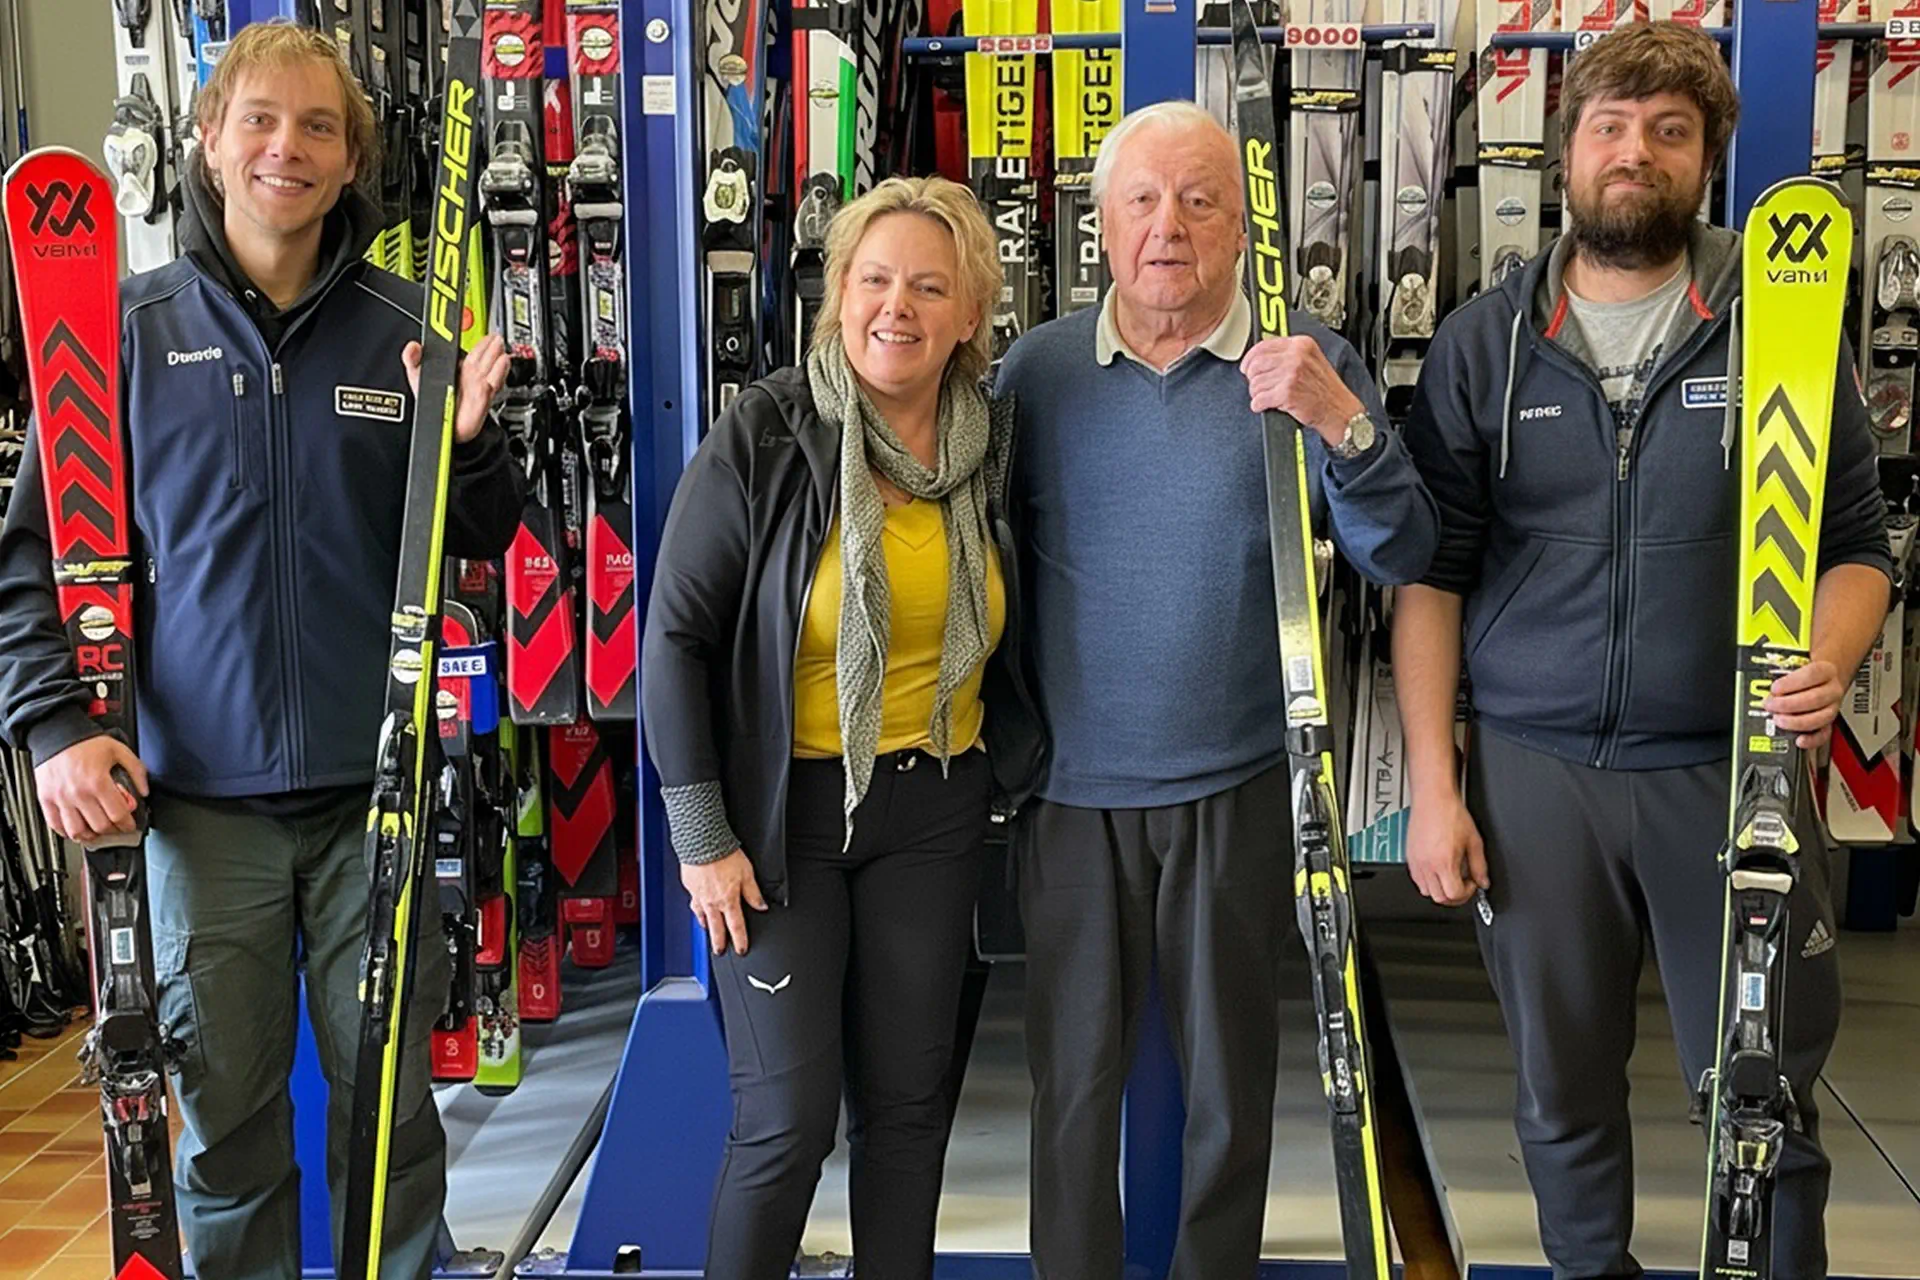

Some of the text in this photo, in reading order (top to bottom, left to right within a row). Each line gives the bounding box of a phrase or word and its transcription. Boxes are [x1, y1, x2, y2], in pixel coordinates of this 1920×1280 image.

[427, 79, 475, 342] FISCHER
[1246, 137, 1290, 340] SCHER
[77, 643, 124, 674] RC
